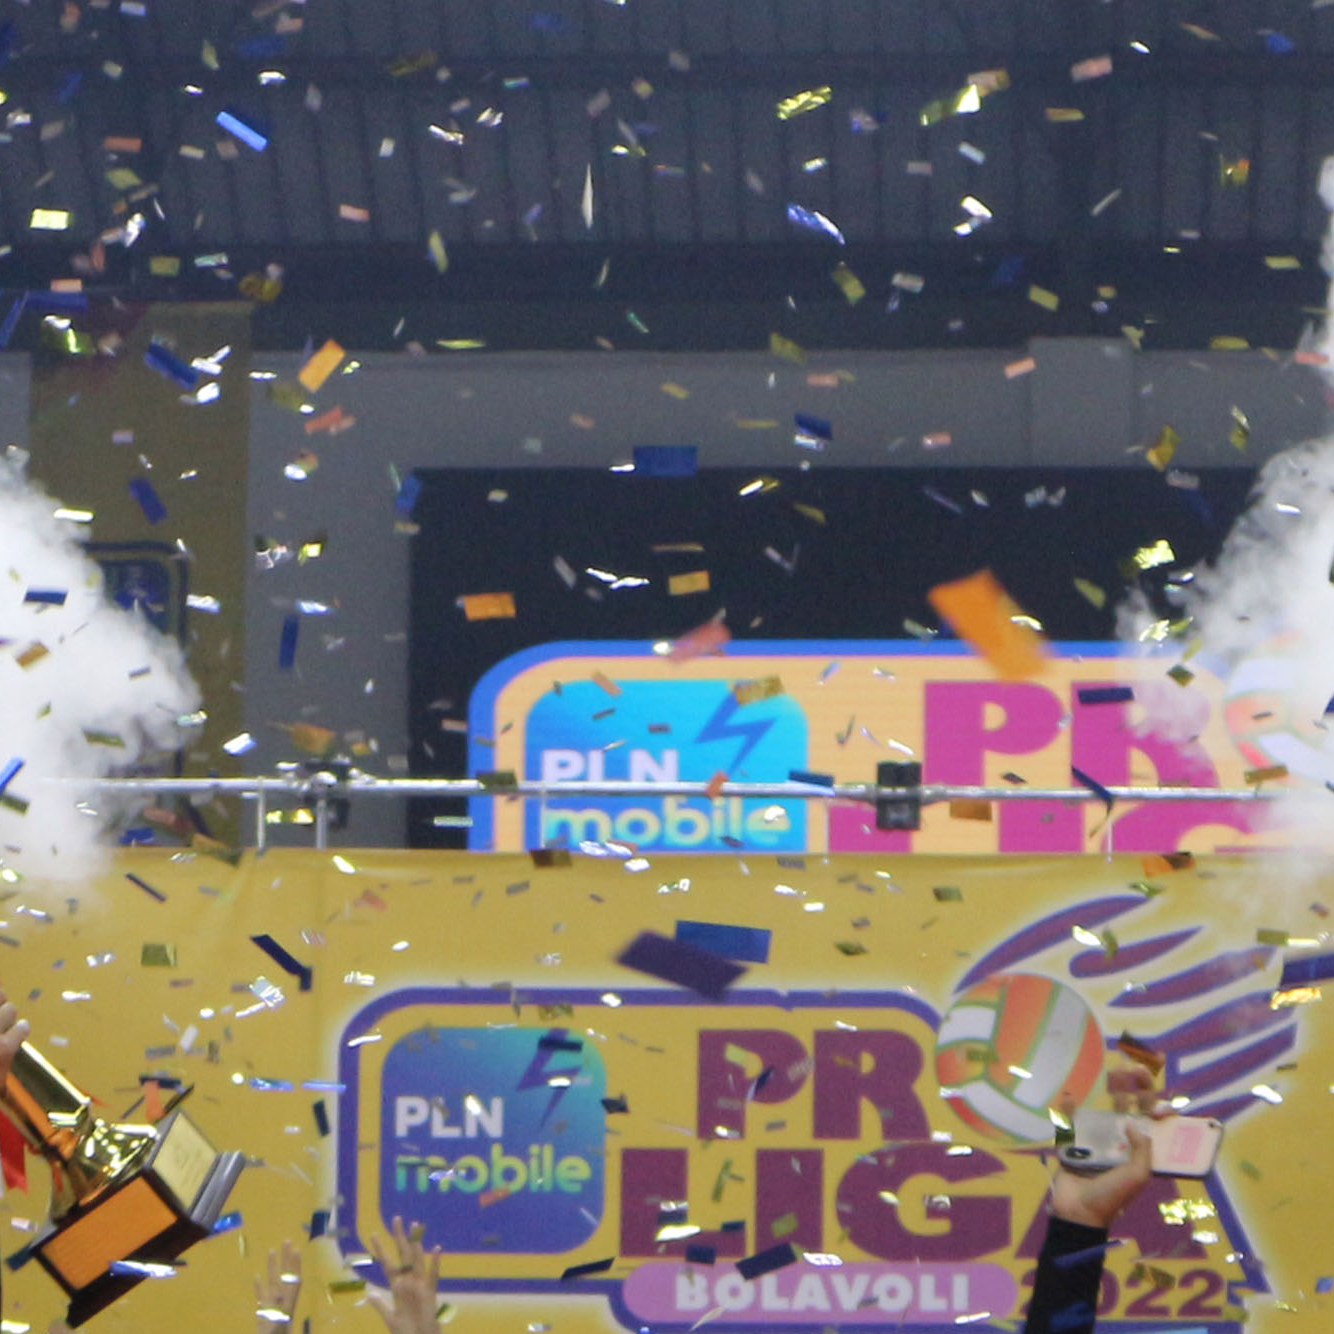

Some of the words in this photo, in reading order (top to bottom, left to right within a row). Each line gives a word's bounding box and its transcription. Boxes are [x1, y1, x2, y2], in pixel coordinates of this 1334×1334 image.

[541, 748, 679, 784] PLN
[543, 792, 792, 846] mobile
[395, 1096, 503, 1139] PLN
[396, 1142, 592, 1193] mobile
[620, 1141, 1209, 1262] LIGA
[675, 1273, 970, 1313] BOLAVOLI
